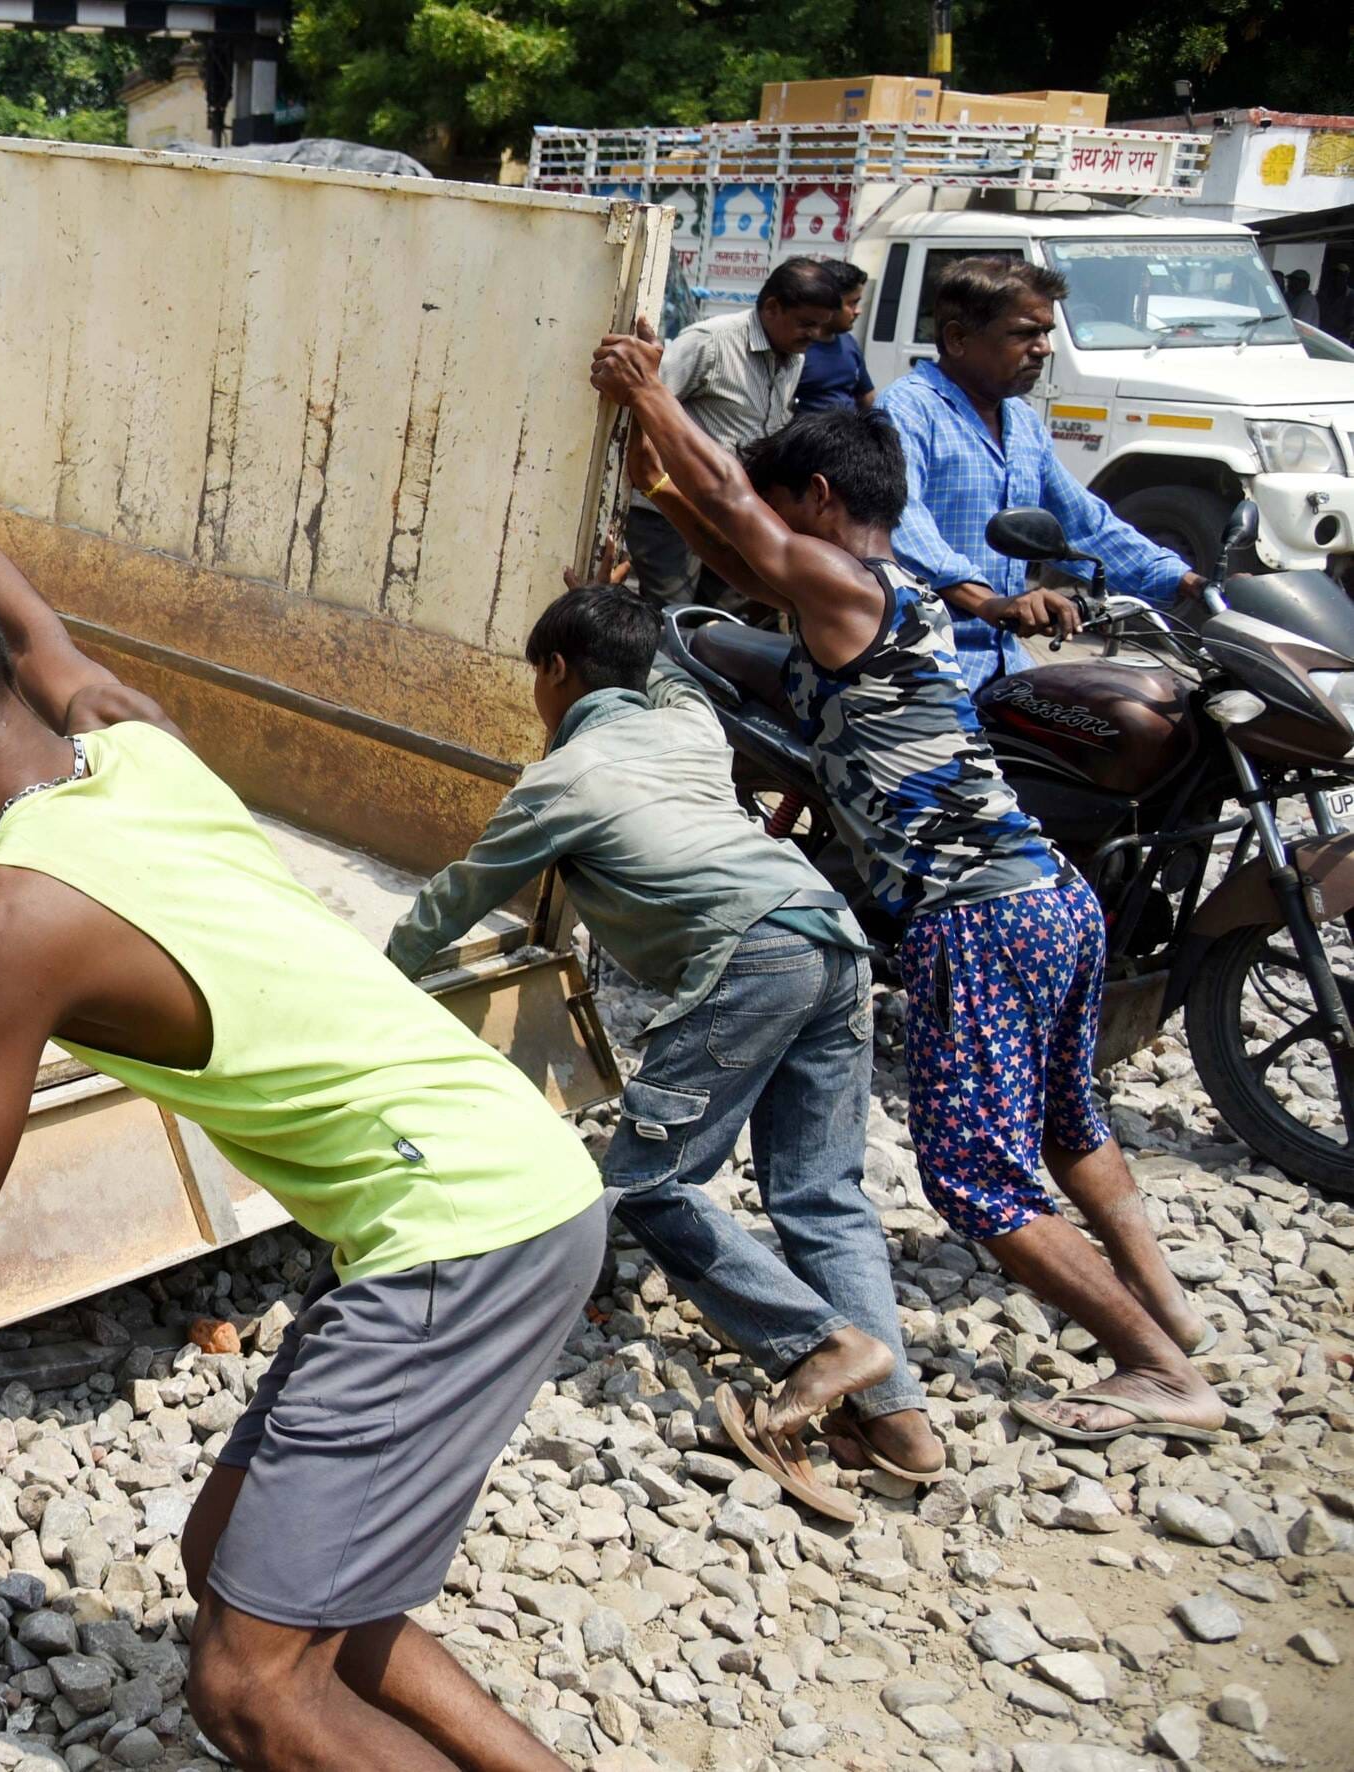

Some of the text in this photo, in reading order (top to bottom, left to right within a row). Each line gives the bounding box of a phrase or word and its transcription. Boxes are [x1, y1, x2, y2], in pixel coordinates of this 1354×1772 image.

[1070, 141, 1158, 176] जय श्री राम
[992, 679, 1120, 737] Passion
[1330, 794, 1353, 815] UP
